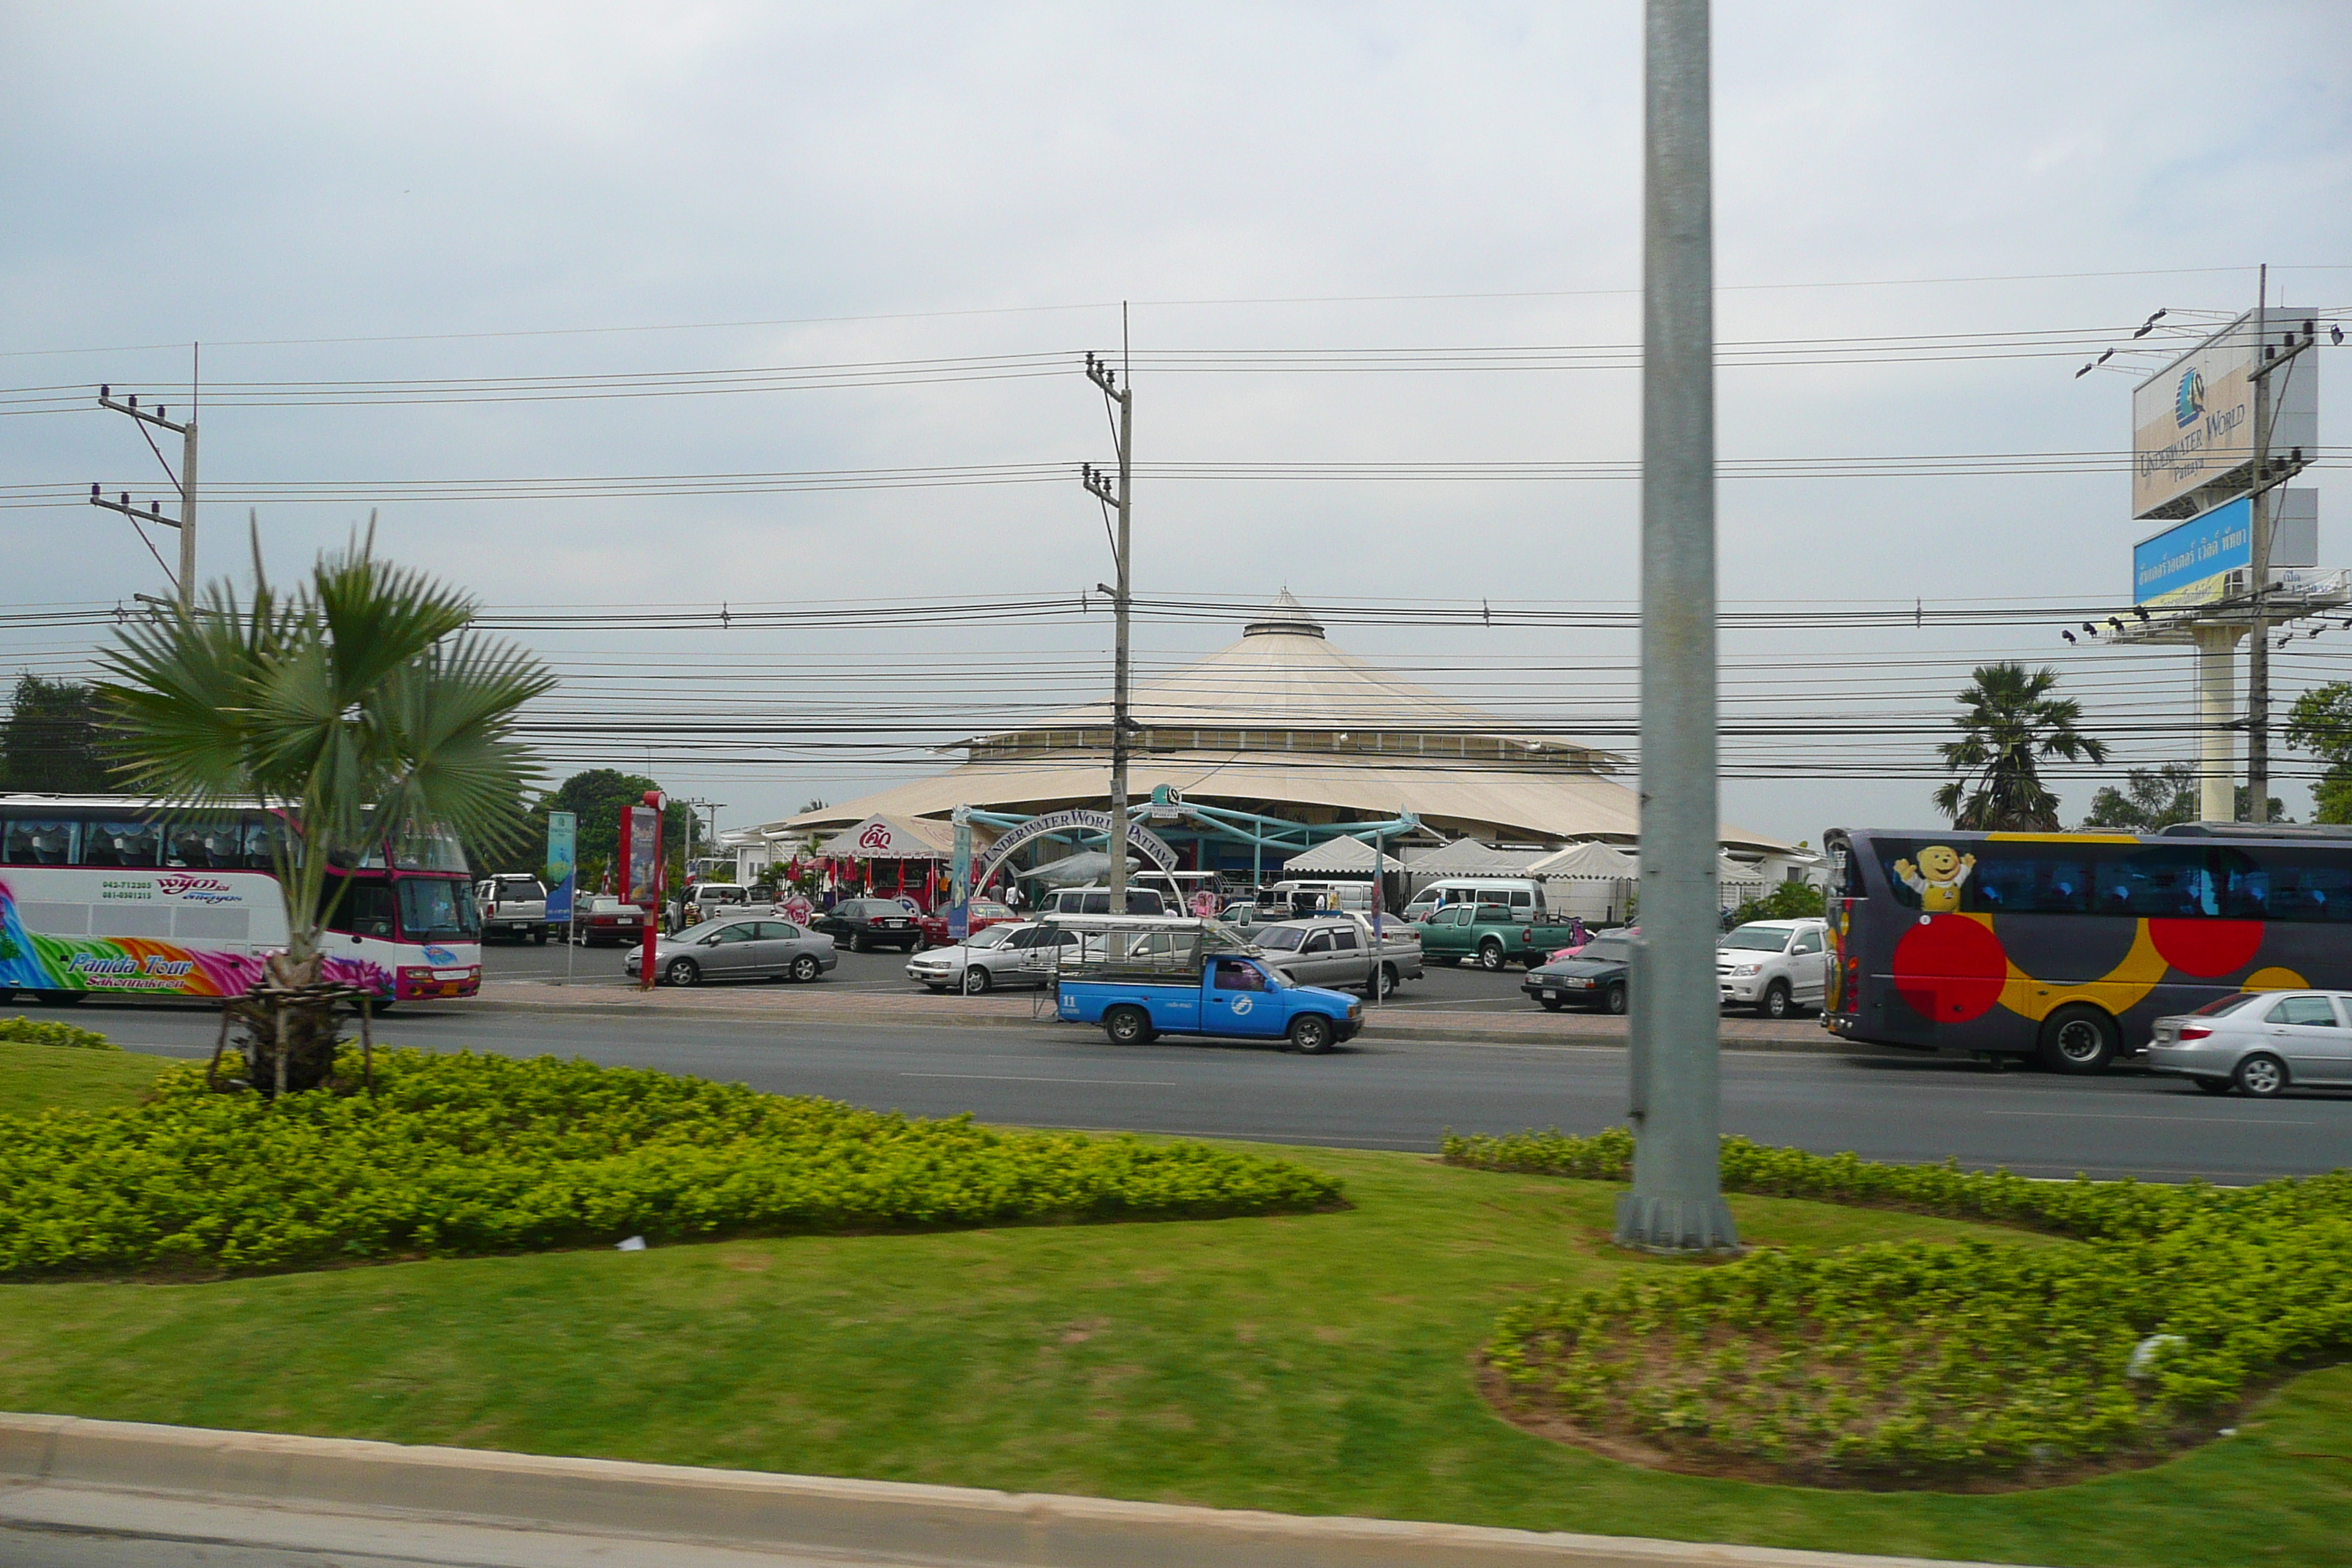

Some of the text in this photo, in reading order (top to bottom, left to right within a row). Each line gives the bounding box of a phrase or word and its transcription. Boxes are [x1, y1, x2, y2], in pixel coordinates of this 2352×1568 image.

[2205, 404, 2245, 441] WORLD
[2174, 457, 2204, 483] Pattaya
[982, 811, 1173, 870] UNDERWATER WORL PATTAYA
[67, 952, 193, 975] Panida Tour
[1063, 995, 1076, 1007] 11
